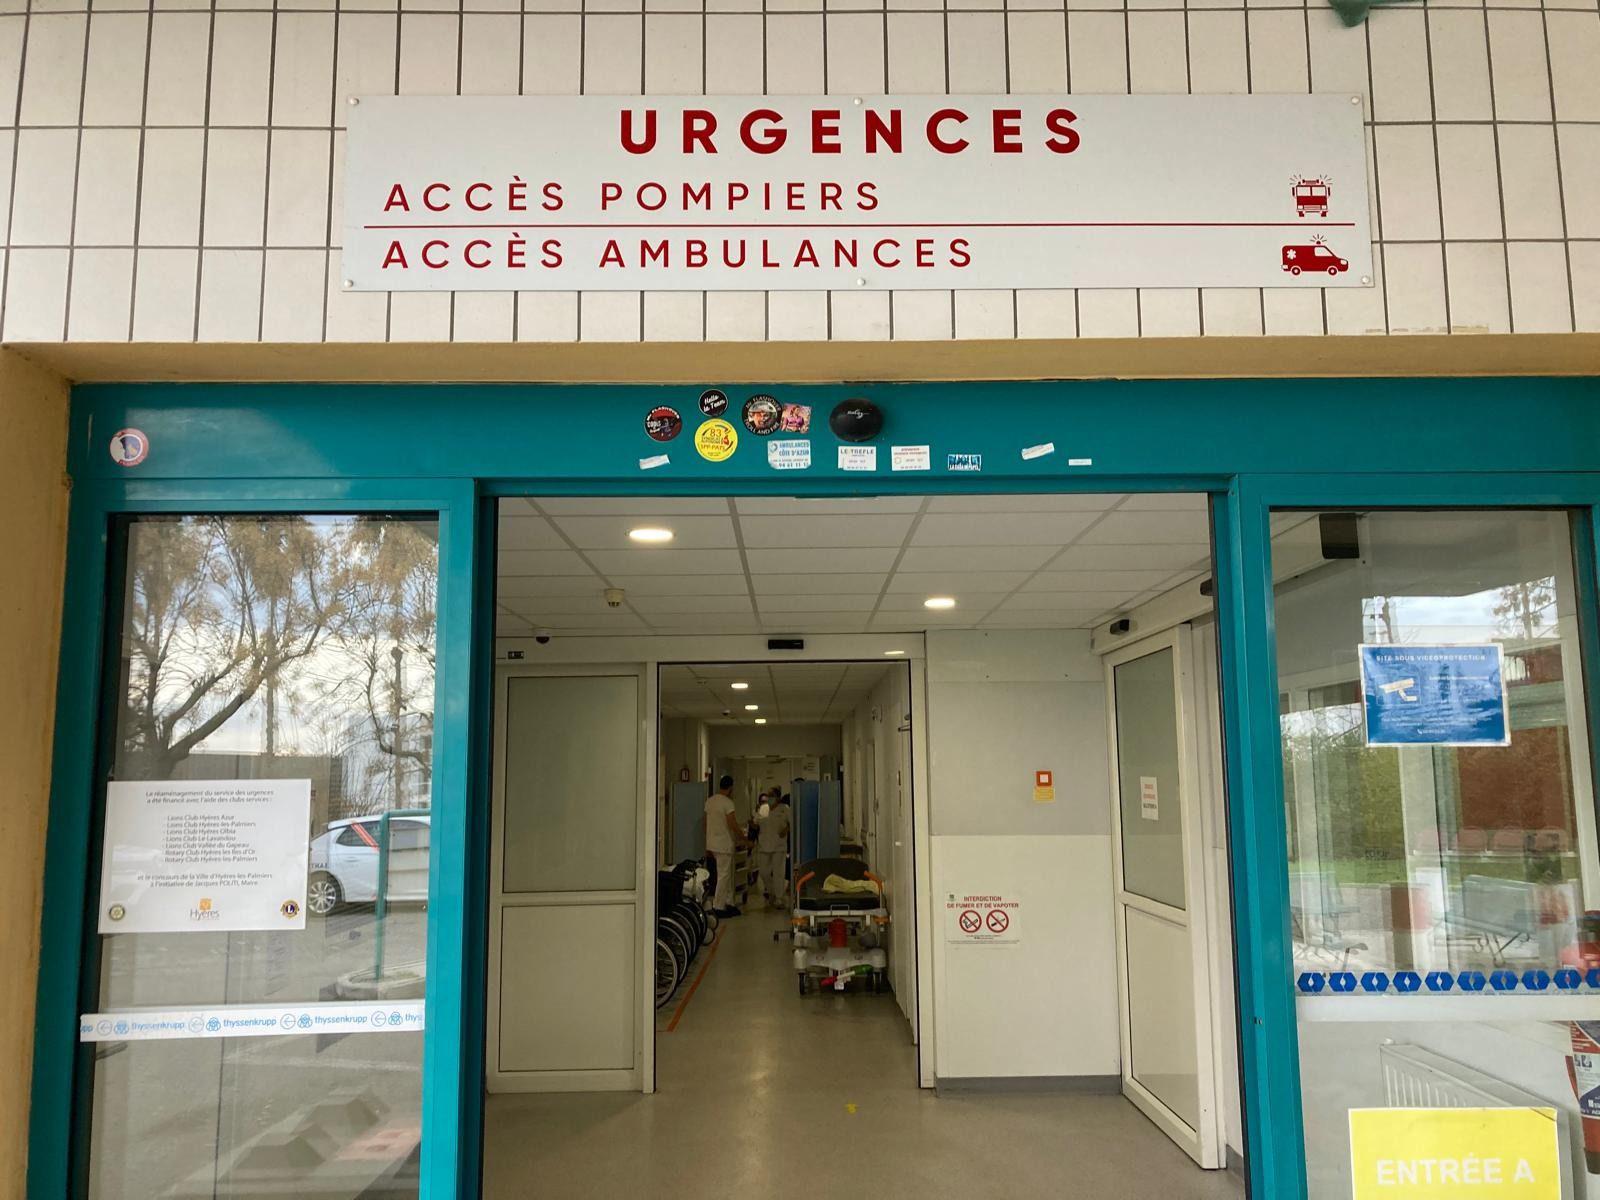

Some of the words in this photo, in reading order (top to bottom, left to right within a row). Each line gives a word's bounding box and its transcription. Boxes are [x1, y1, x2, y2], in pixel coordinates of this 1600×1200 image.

[620, 107, 1080, 155] URGENCES
[384, 175, 564, 212] ACCÈS
[601, 181, 879, 212] POMPIERS
[382, 233, 564, 269] ACCÈS
[600, 239, 971, 269] AMBULANCES
[710, 428, 721, 437] 83
[131, 1019, 186, 1032] thyssenkrupp
[223, 1016, 277, 1030] thyssenkrupp
[314, 1014, 368, 1028] thyssenkrupp
[1376, 1152, 1503, 1185] ENTRÉE
[1513, 1158, 1536, 1185] A
